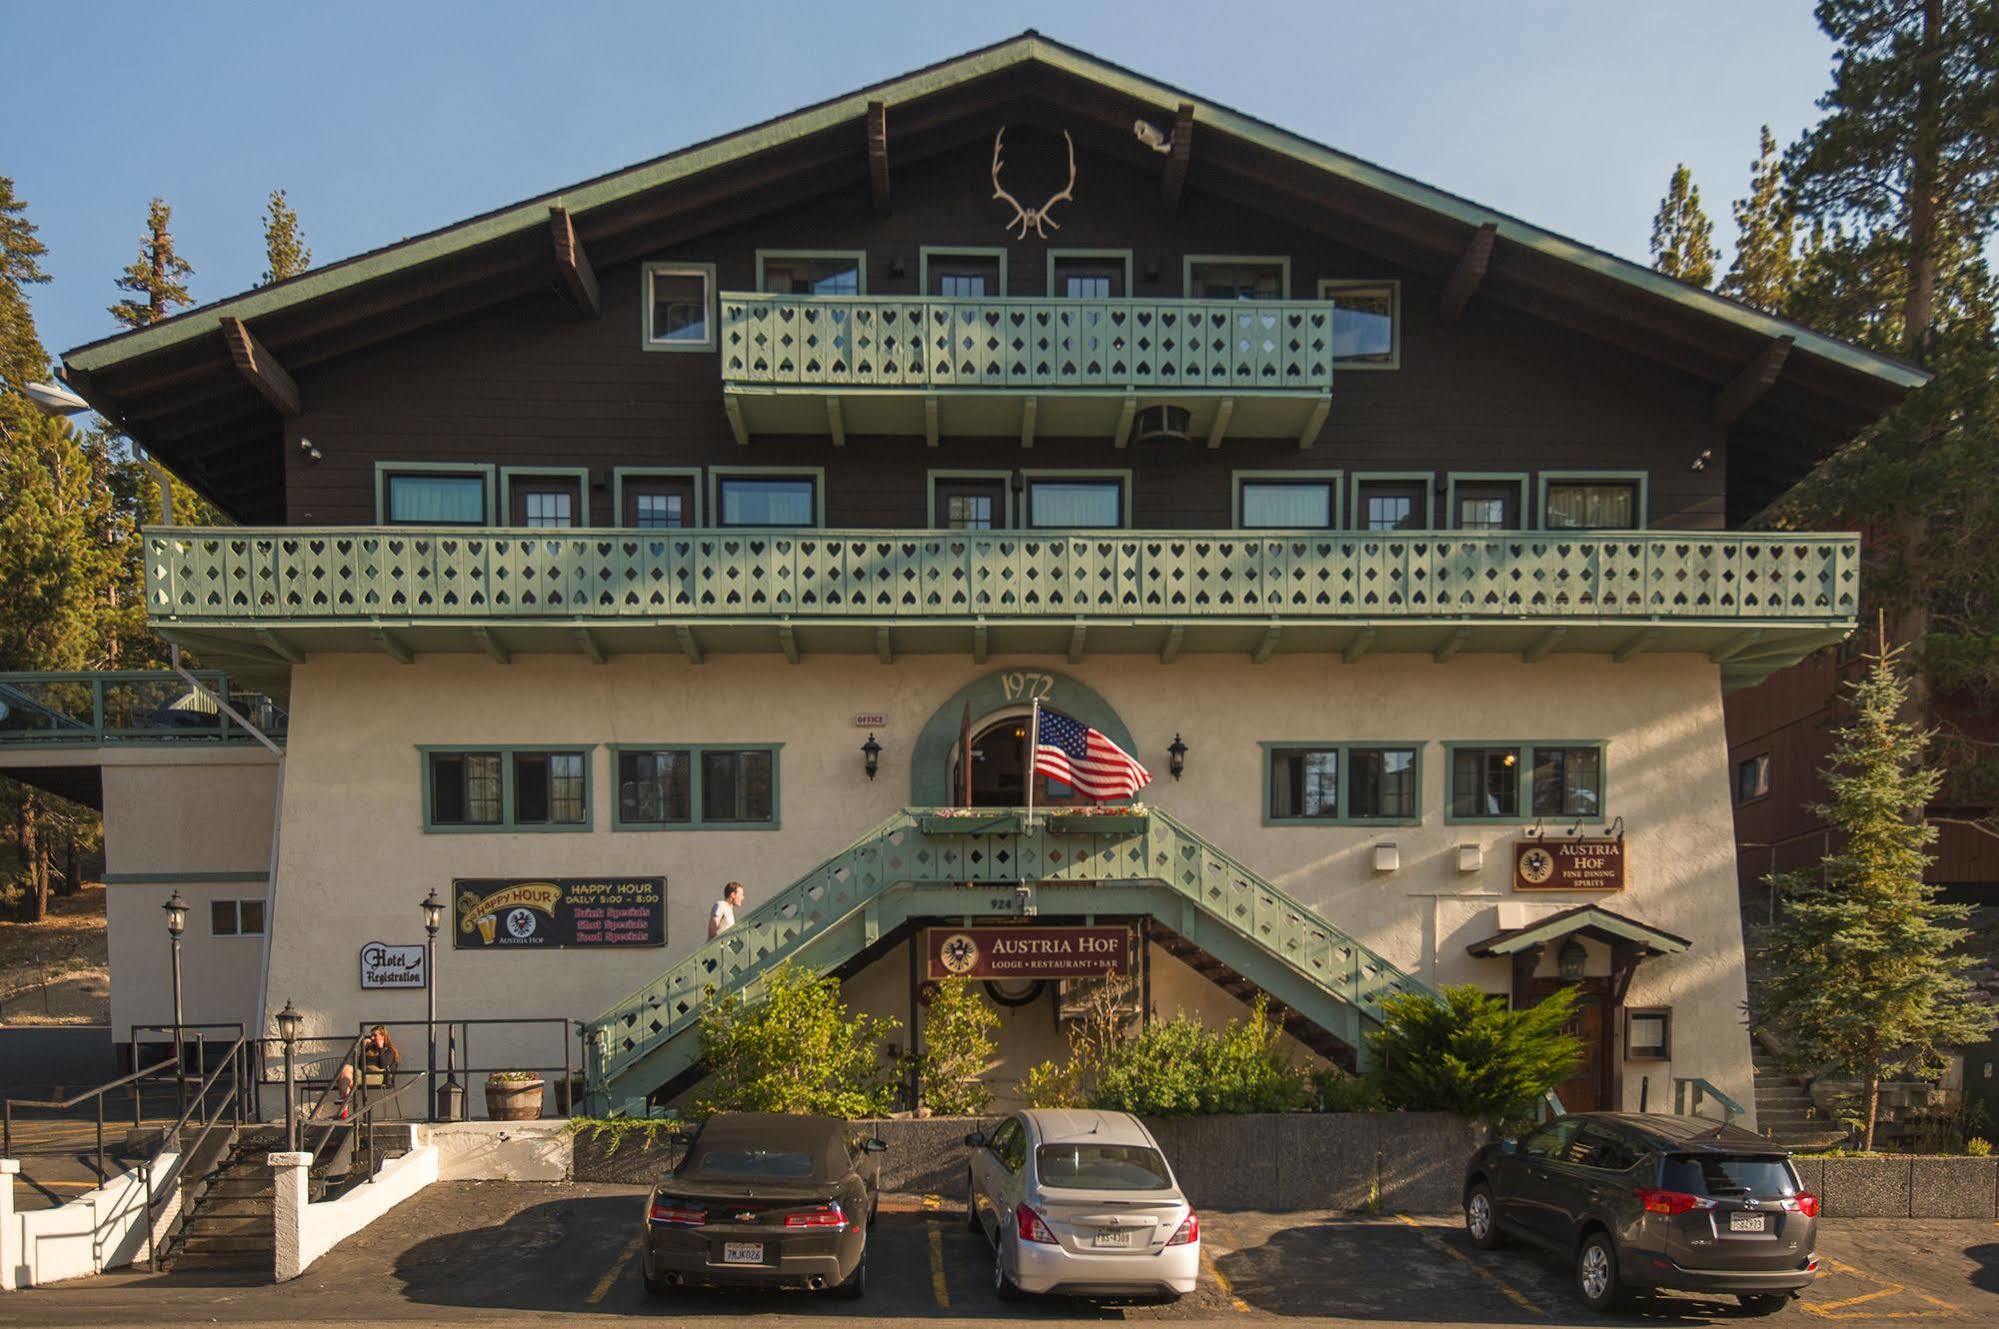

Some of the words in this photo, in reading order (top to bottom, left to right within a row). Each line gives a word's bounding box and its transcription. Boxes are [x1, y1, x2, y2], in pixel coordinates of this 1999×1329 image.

[1001, 672, 1054, 700] 1972
[857, 715, 883, 724] OFFICE
[1560, 844, 1619, 855] AUSTRIA
[1574, 857, 1605, 869] HOF
[571, 884, 612, 894] HAPPY
[617, 883, 652, 894] HOUR
[1574, 879, 1604, 887] SPIRITS
[512, 889, 552, 902] HOUR
[566, 895, 596, 904] DAILY
[990, 899, 1012, 909] 924
[991, 939, 1073, 954] AUSTRIA
[1079, 937, 1119, 953] HOF
[364, 948, 405, 970] Hotel
[991, 961, 1023, 969] LODGE
[1031, 960, 1093, 968] RESTAURANT
[1099, 959, 1118, 968] BAR
[366, 971, 420, 985] Registration
